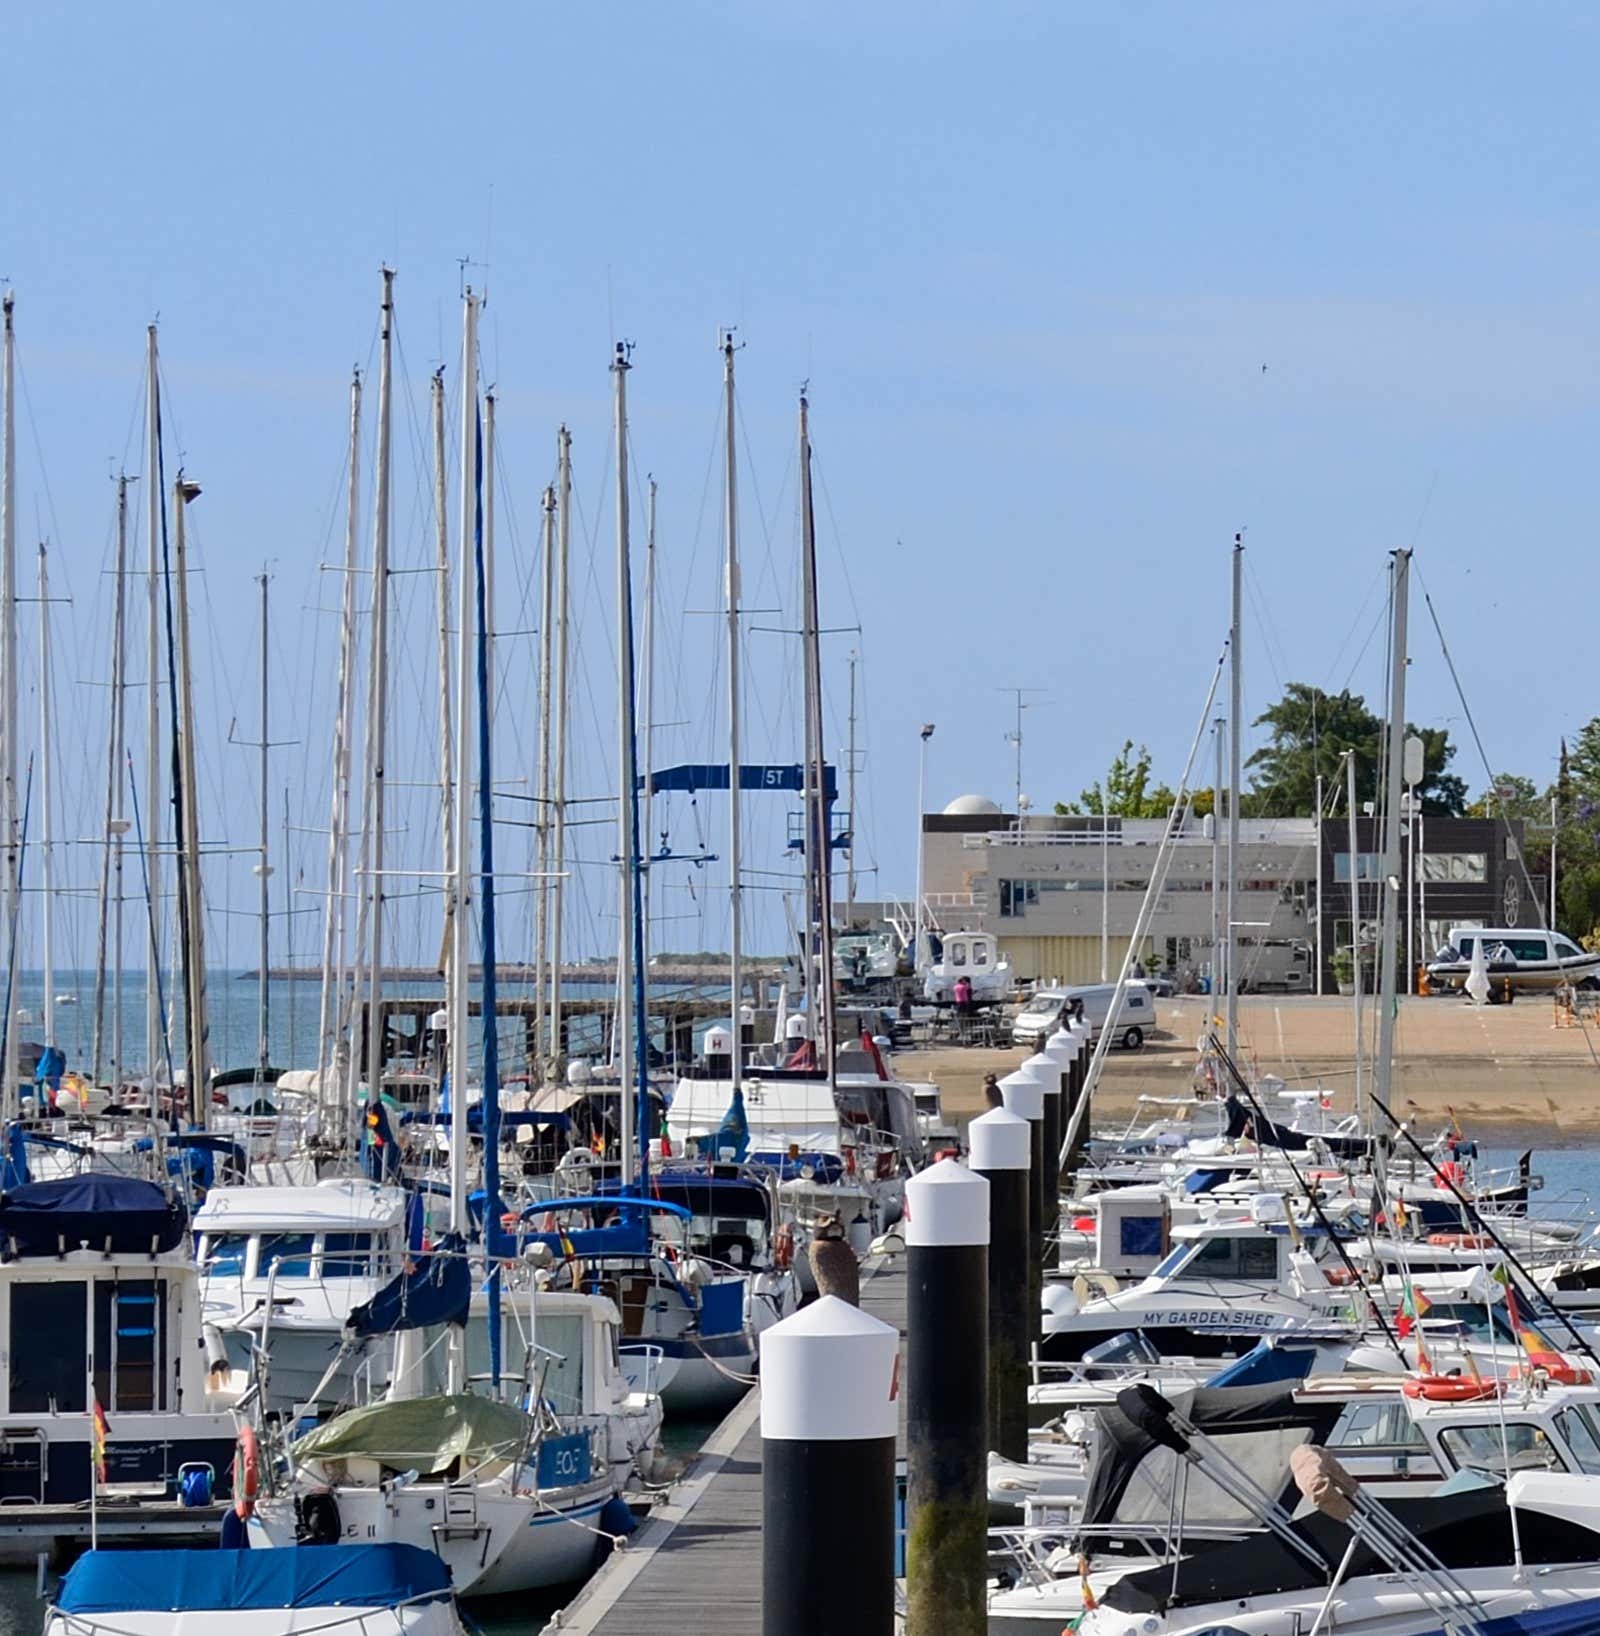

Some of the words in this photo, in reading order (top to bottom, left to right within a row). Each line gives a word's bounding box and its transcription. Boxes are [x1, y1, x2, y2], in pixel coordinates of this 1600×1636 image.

[766, 770, 784, 784] 5T
[713, 1040, 721, 1048] H
[1144, 1313, 1164, 1324] MY
[1168, 1312, 1229, 1324] GARDEN
